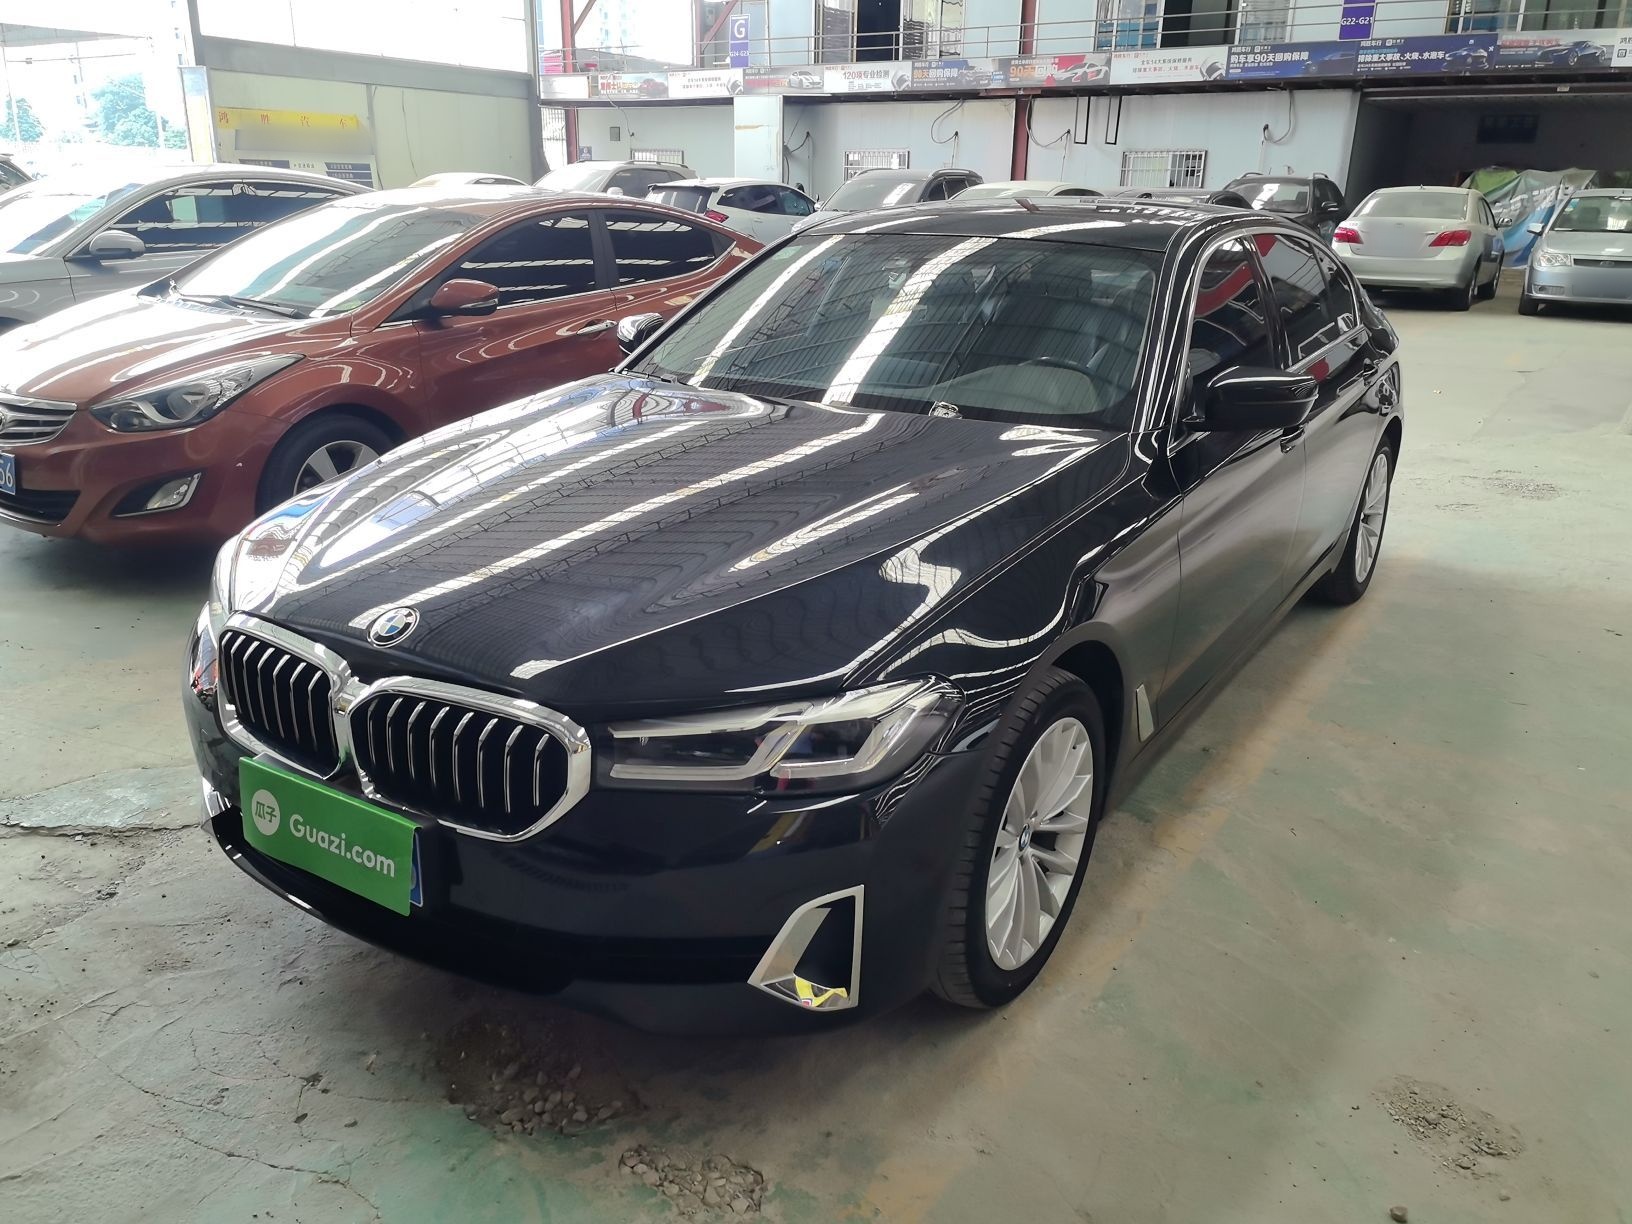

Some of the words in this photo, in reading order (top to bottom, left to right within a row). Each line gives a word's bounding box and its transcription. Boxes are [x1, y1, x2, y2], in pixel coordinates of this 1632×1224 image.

[1341, 16, 1373, 26] G22-G21
[735, 20, 745, 38] G
[1230, 51, 1309, 63] 购车享90天回购保障
[842, 70, 890, 80] 120项专业检测
[254, 801, 277, 823] 瓜子
[289, 813, 395, 878] Guazi.com
